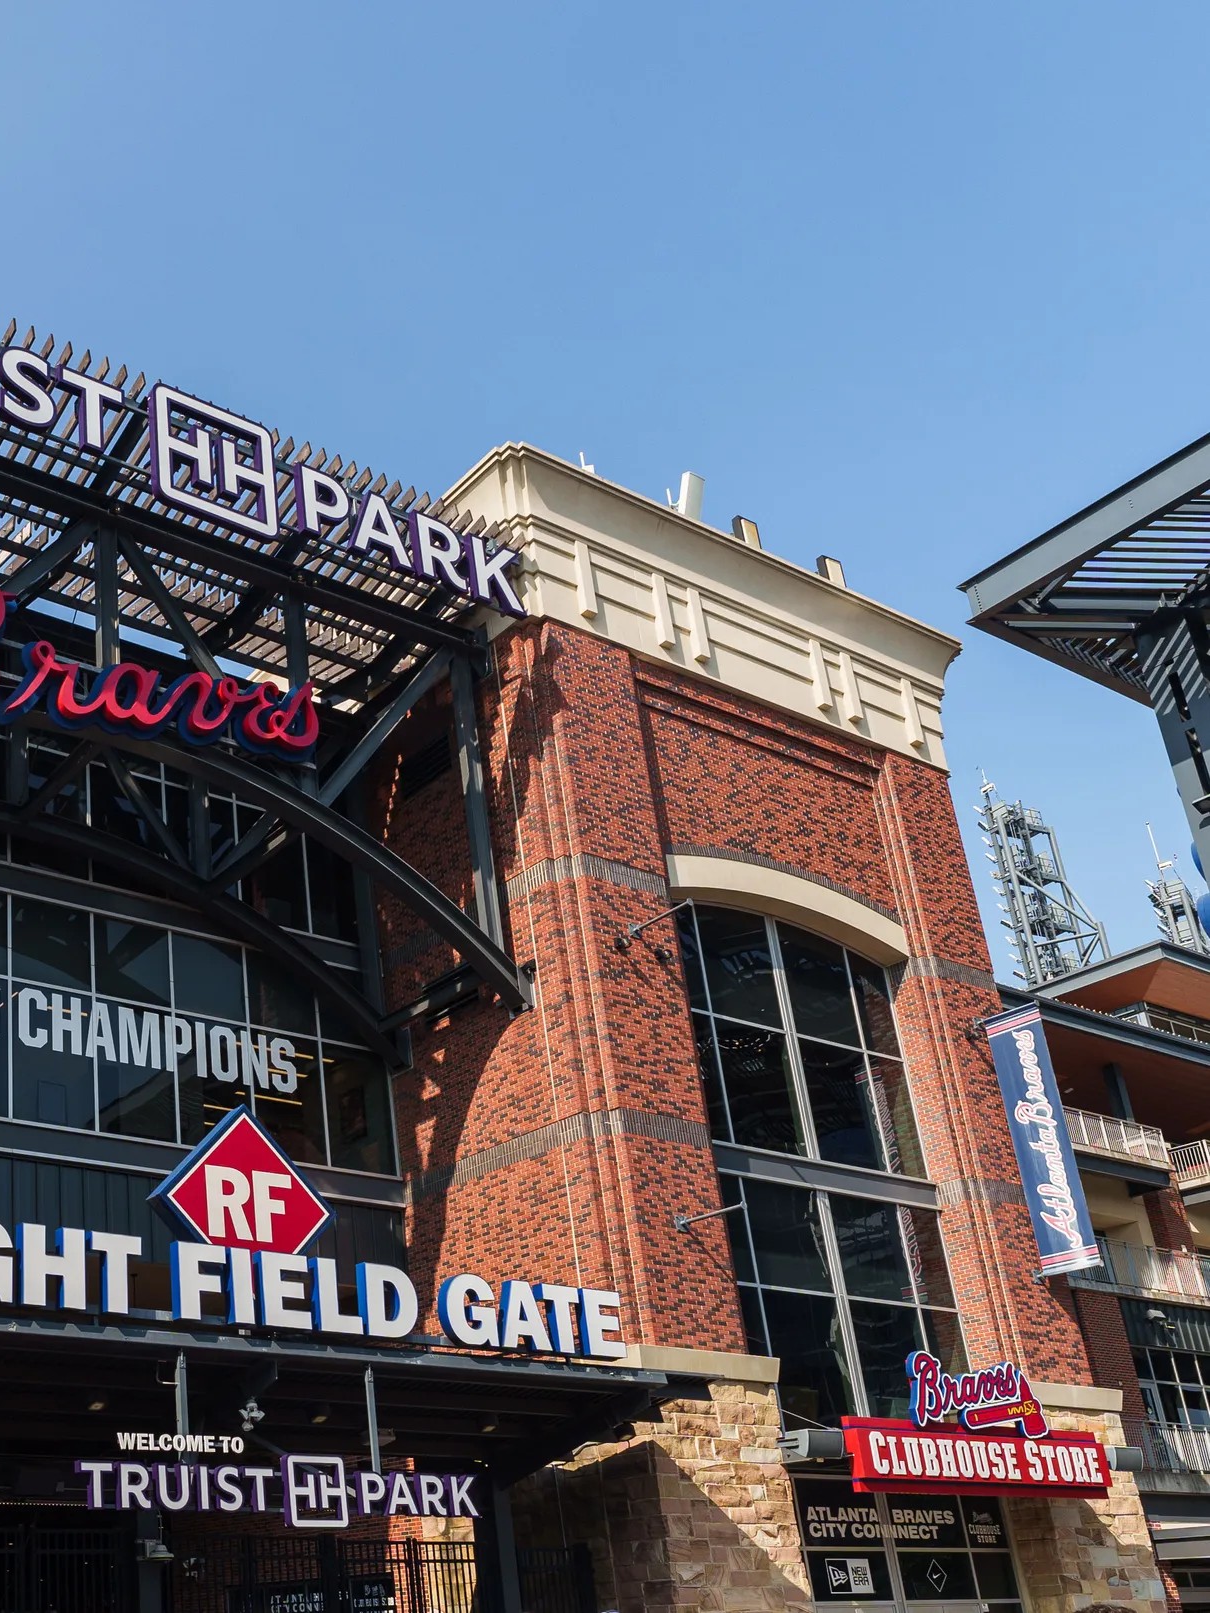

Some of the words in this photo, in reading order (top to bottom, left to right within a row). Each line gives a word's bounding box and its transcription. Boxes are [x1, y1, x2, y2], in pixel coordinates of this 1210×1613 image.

[294, 462, 527, 617] PARK
[18, 988, 298, 1094] CHAMPIONS
[1012, 1029, 1058, 1127] Braves
[204, 1164, 292, 1243] RF
[1030, 1126, 1083, 1248] Atlanta
[170, 1241, 419, 1338] FIELD
[438, 1274, 627, 1358] GATE
[909, 1350, 1017, 1427] Braves
[117, 1432, 216, 1453] WELCOME
[220, 1436, 244, 1454] TO
[76, 1461, 274, 1512] TRUIST
[357, 1471, 480, 1517] PARK
[807, 1506, 881, 1522] ATLANTA
[892, 1509, 955, 1525] BRAVES
[809, 1523, 847, 1538] CITY
[851, 1566, 868, 1576] NEW
[853, 1576, 870, 1586] ERA
